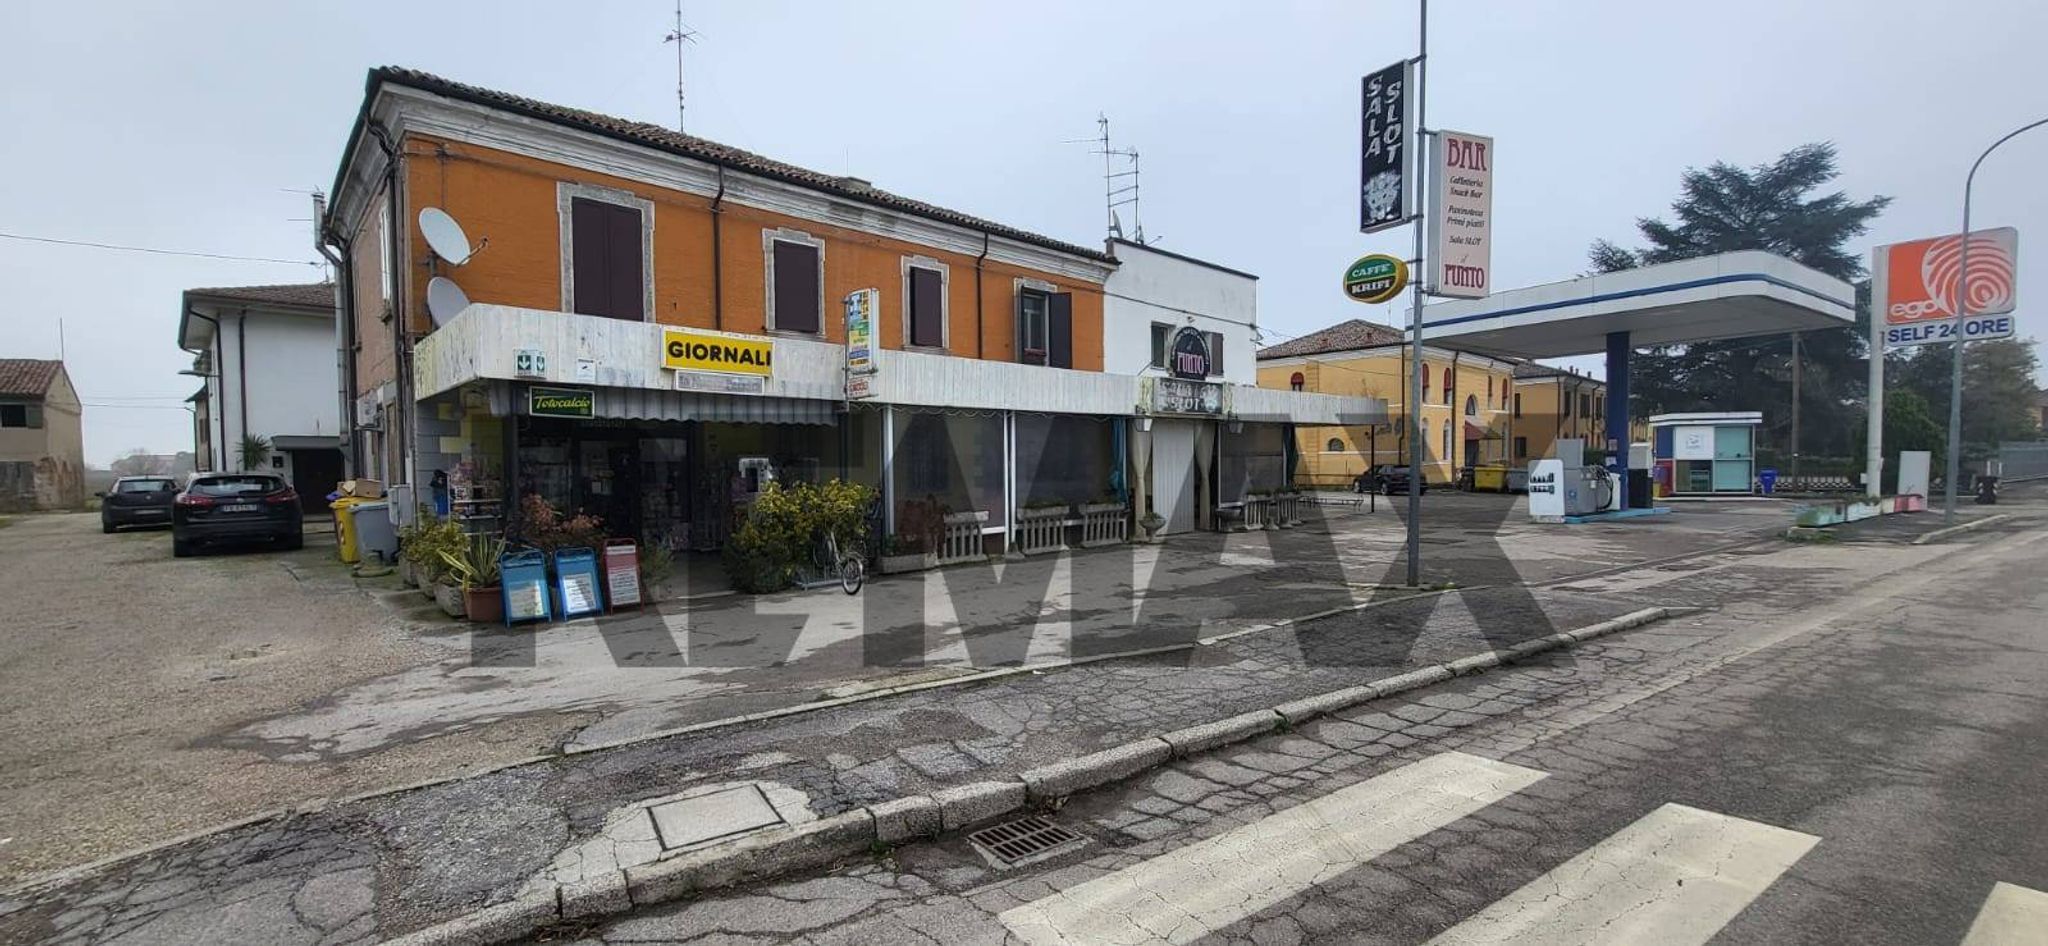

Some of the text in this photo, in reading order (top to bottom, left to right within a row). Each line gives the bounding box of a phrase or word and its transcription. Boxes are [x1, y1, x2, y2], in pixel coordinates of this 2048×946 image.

[1364, 75, 1383, 158] SALA
[1383, 81, 1402, 164] SLOT
[1447, 138, 1487, 171] BAR
[1351, 279, 1392, 294] KRIFI
[1444, 263, 1485, 289] PUNTO
[1891, 300, 1938, 318] ego
[1888, 325, 1935, 342] SELF
[1965, 318, 2009, 335] ORE
[668, 341, 771, 366] GIORNALI
[534, 395, 590, 409] Totocalcio
